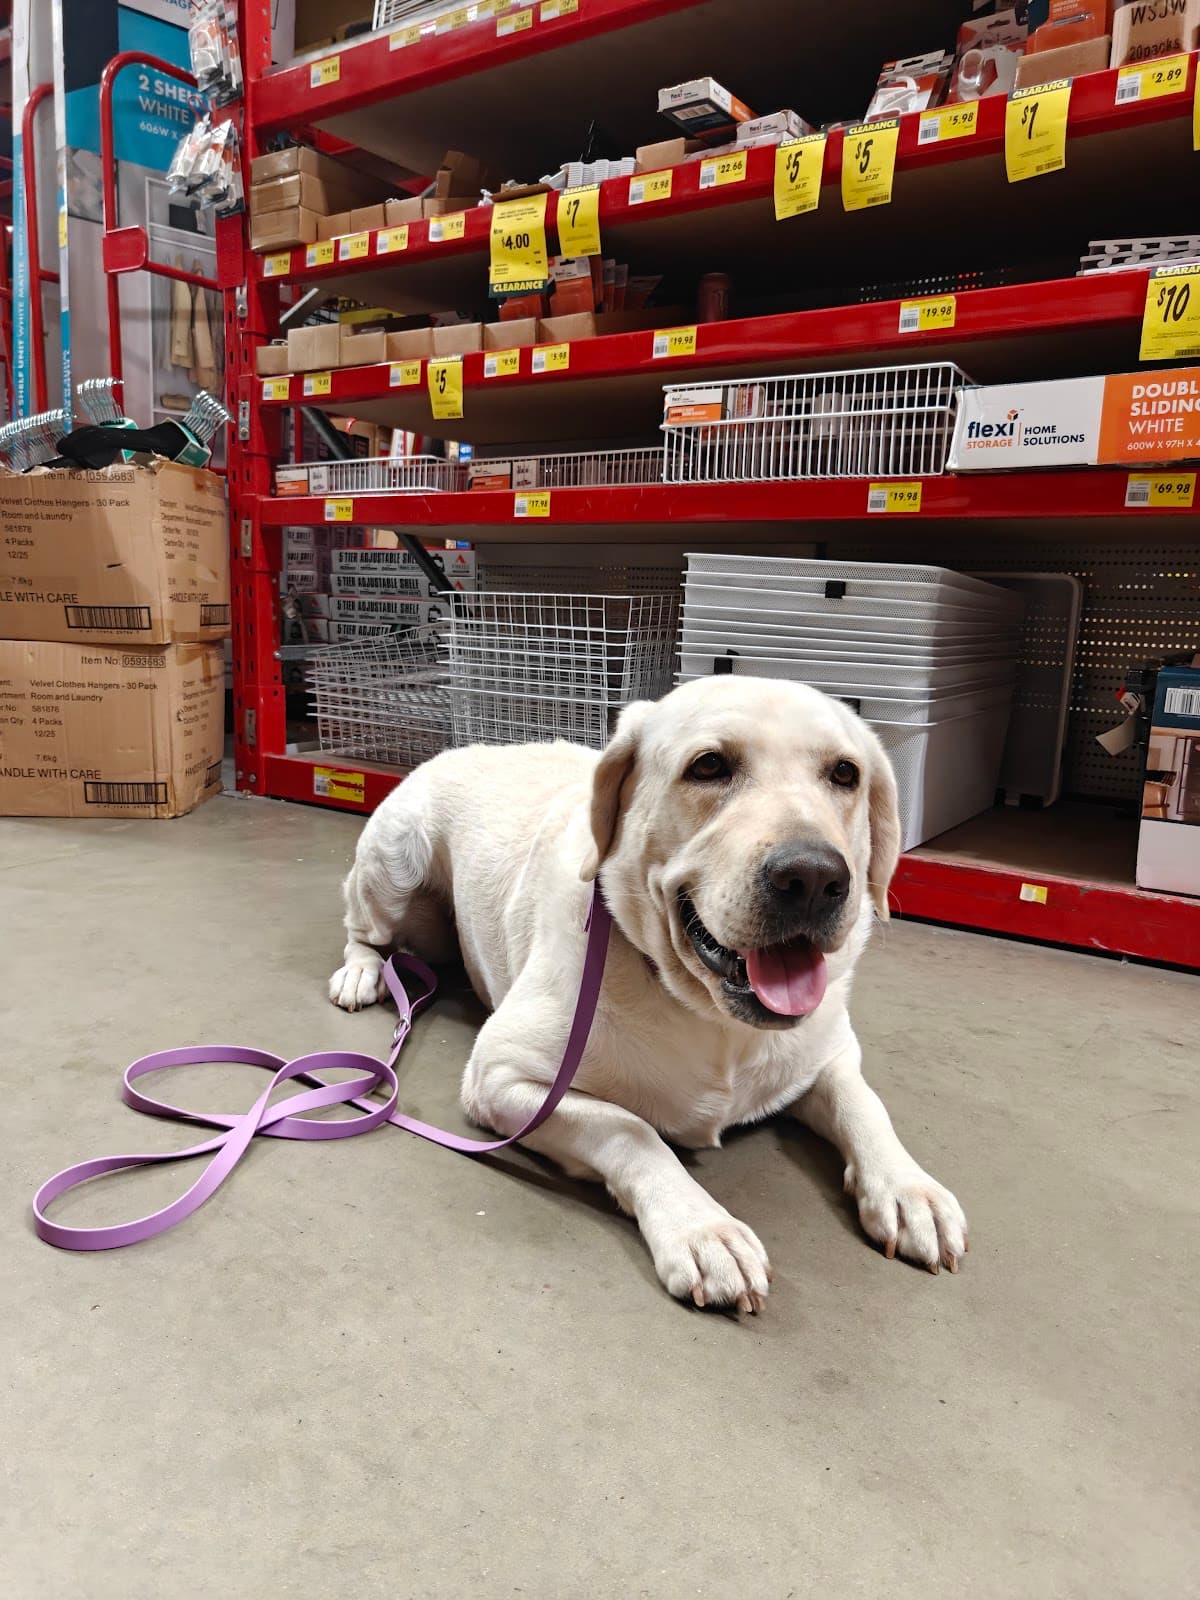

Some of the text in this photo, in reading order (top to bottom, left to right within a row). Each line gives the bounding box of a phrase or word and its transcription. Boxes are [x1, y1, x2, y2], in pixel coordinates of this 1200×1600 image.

[138, 74, 150, 91] 2
[1152, 68, 1182, 84] $2.89
[1012, 79, 1069, 100] CLEARANCE
[138, 95, 189, 124] WHITE
[948, 112, 974, 127] $5.98
[1021, 101, 1039, 140] $1
[848, 119, 898, 135] CLEARANCE
[855, 139, 874, 174] $5
[786, 150, 803, 184] $5
[566, 198, 580, 229] $7
[502, 232, 530, 251] $4.00
[1155, 264, 1200, 278] CLEARA
[493, 280, 543, 294] CLEARANCE
[1157, 282, 1190, 323] $10
[922, 305, 952, 318] $19.98
[435, 369, 447, 394] $5
[967, 420, 1014, 439] flexi
[1024, 425, 1057, 437] HOME
[1128, 418, 1184, 435] WHITE
[966, 438, 1013, 451] STORAGE
[1023, 433, 1085, 448] SOLUTIONS
[1127, 441, 1155, 450] 600W
[1156, 440, 1164, 449] X
[1165, 440, 1185, 449] 97H
[1186, 439, 1194, 448] X
[1155, 482, 1191, 495] $69.98
[25, 498, 54, 506] Clothes
[55, 499, 89, 508] Hangers
[97, 498, 107, 507] 30
[109, 499, 130, 508] Pack
[890, 491, 918, 502] $19.98
[1, 510, 73, 523] Room and Laundry
[10, 538, 35, 546] Packs
[8, 551, 29, 560] 12/25
[344, 552, 358, 565] TIER
[360, 552, 401, 565] ADJUSTABLE
[342, 576, 356, 589] TIER
[358, 576, 398, 590] ADJUSTABLE
[400, 577, 419, 590] SHELF
[15, 592, 44, 603] WITH
[47, 593, 80, 604] CARE
[342, 598, 356, 612] TIER
[358, 599, 398, 613] ADJUSTABLE
[400, 600, 419, 613] SHELF
[358, 624, 392, 636] ADJUSTA
[81, 655, 102, 665] Item
[124, 656, 165, 666] 0593683
[30, 680, 54, 688] Velvet
[56, 680, 86, 689] Clothes
[87, 681, 120, 691] Hangers
[126, 682, 137, 690] 30
[138, 682, 158, 690] Pack
[30, 693, 54, 701] Room
[55, 693, 70, 701] and
[71, 693, 103, 703] Laundry
[39, 718, 63, 727] Packs
[34, 730, 56, 739] 12/25
[37, 768, 68, 779] WITH
[70, 769, 102, 780] CARE
